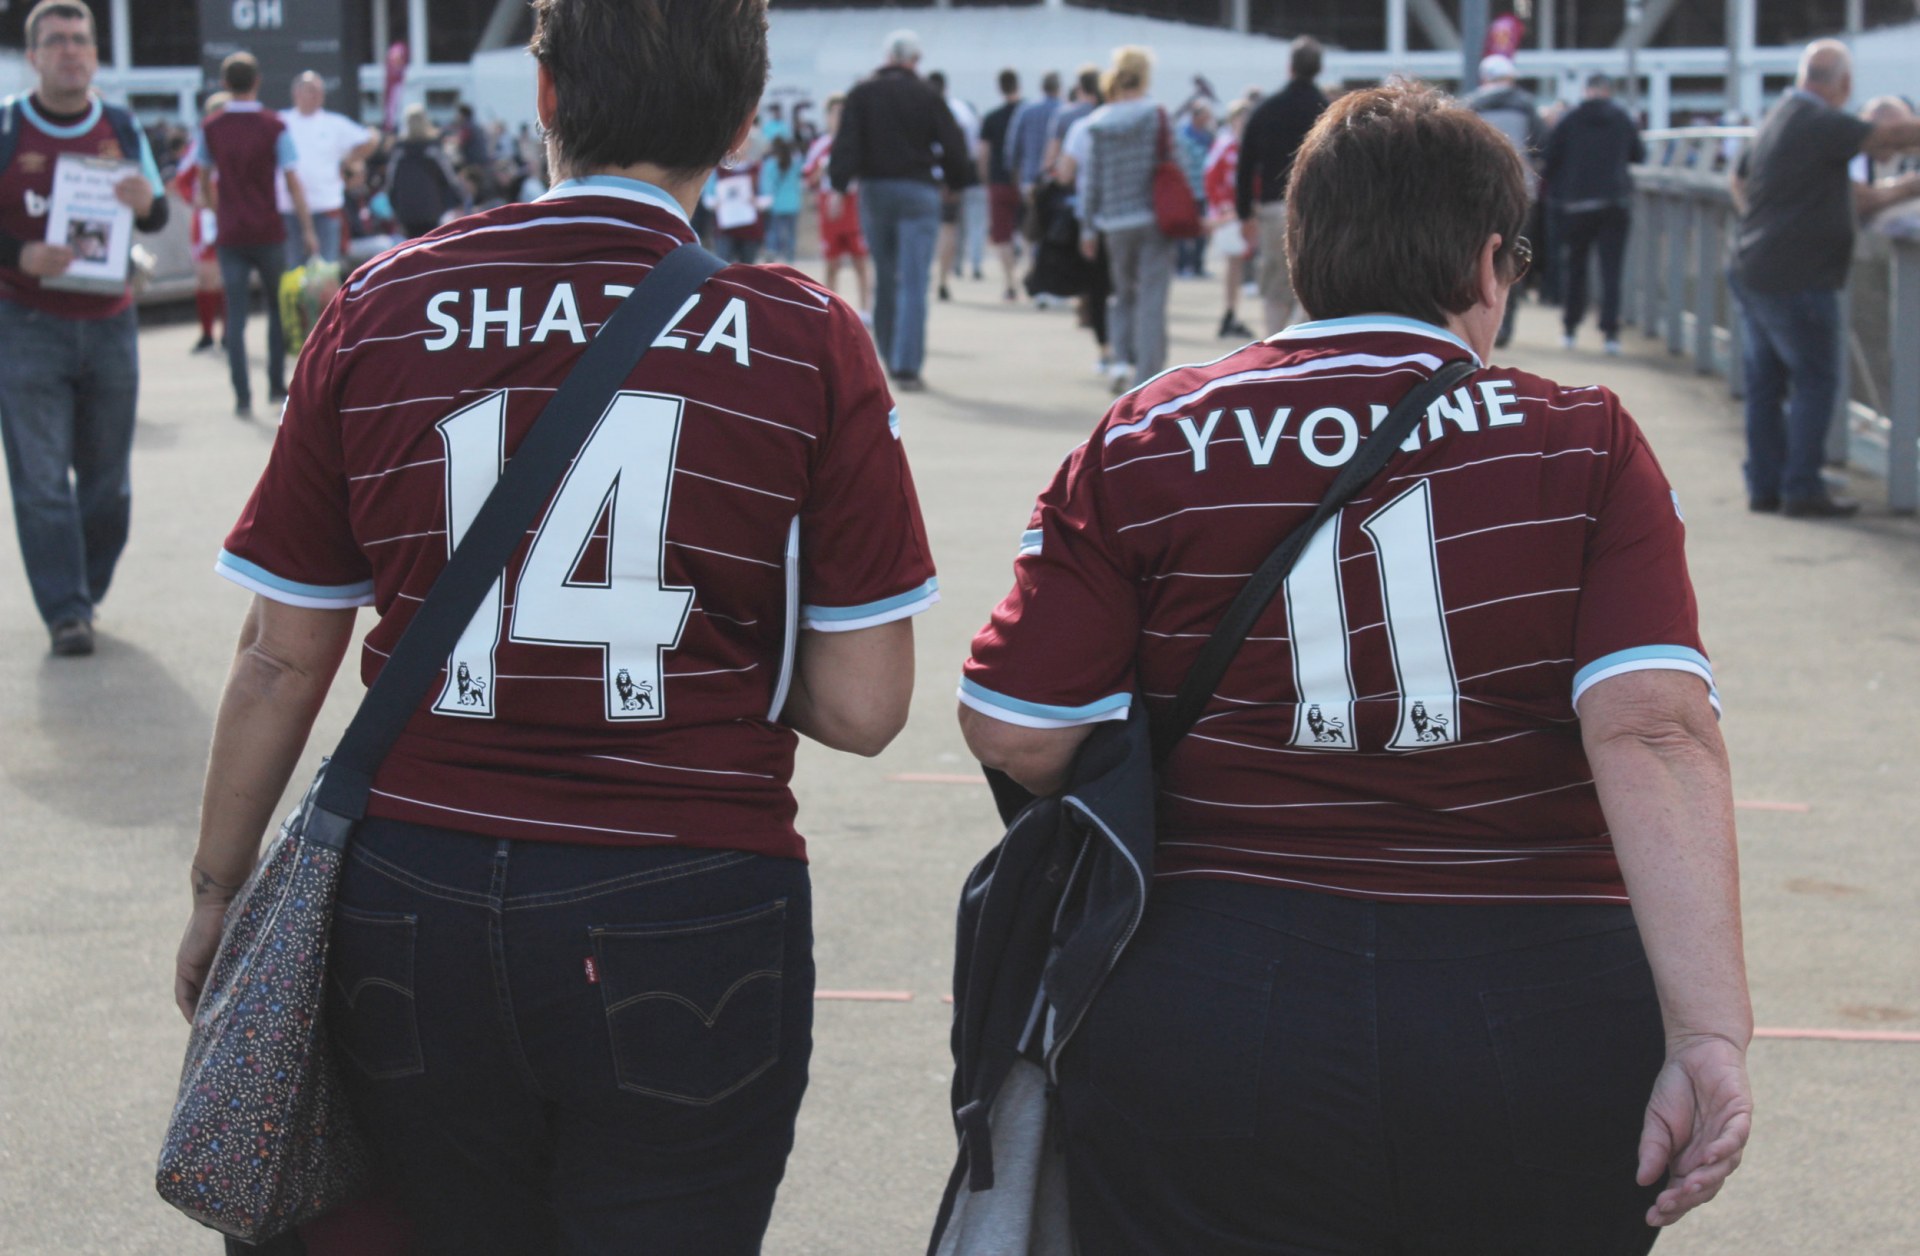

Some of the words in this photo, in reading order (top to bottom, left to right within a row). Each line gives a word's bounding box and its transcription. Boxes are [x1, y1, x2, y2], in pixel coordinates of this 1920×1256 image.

[231, 0, 283, 30] GH
[431, 387, 696, 722] 14
[1283, 477, 1462, 752] 11
